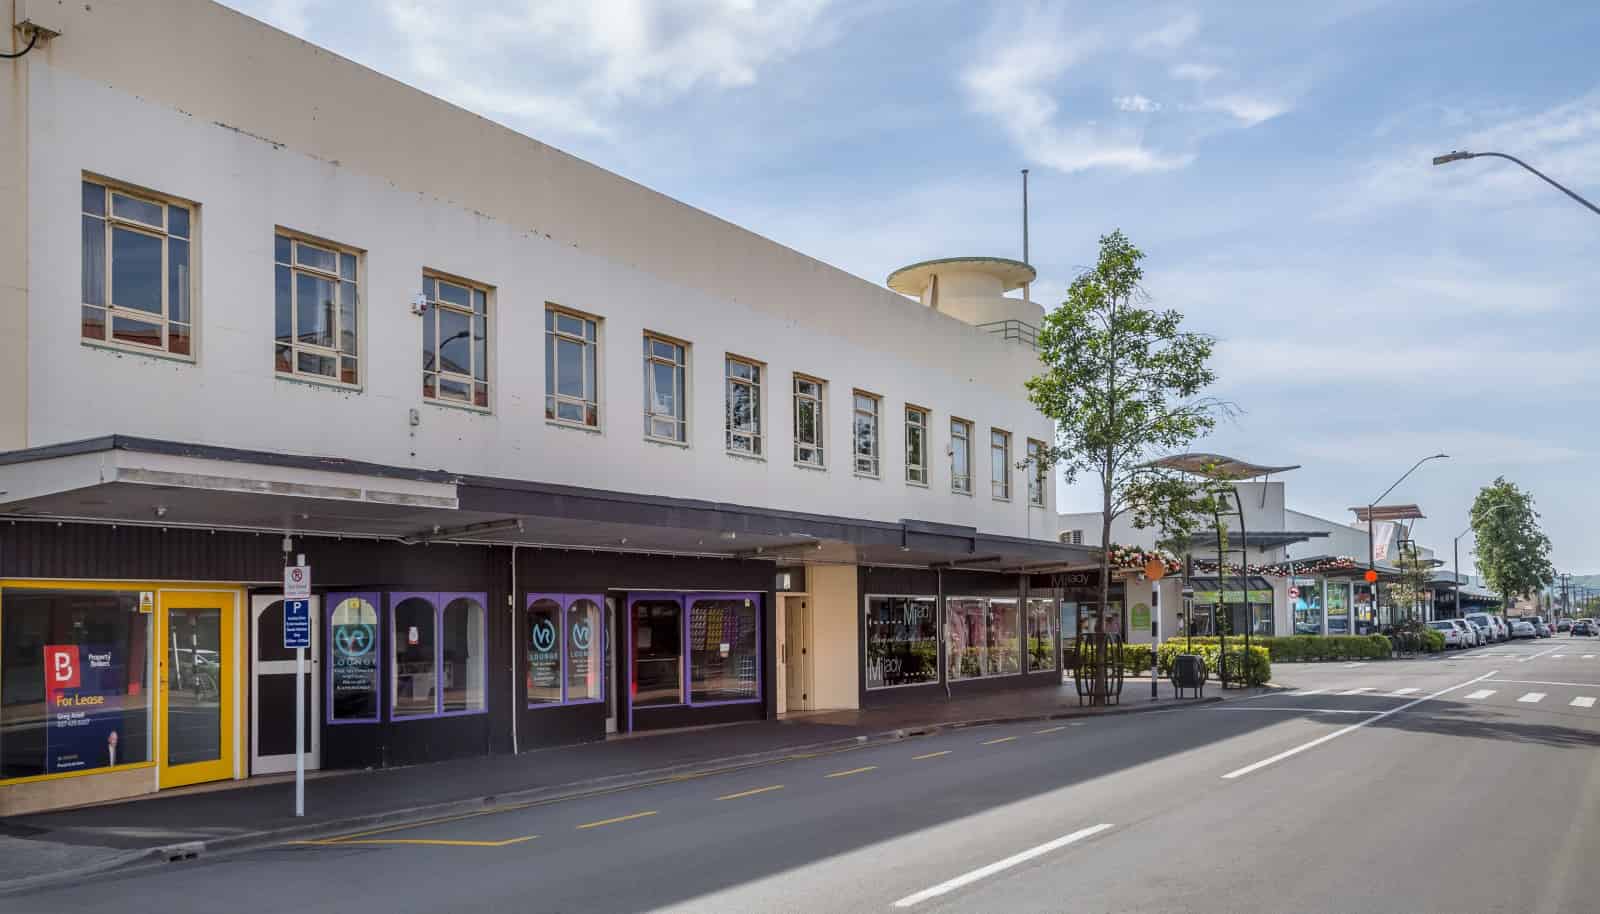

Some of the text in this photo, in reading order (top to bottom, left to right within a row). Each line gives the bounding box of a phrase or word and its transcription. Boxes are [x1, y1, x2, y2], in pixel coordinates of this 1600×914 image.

[293, 601, 302, 614] P
[55, 652, 73, 681] B
[869, 655, 902, 681] Milady
[57, 694, 104, 706] For Lease
